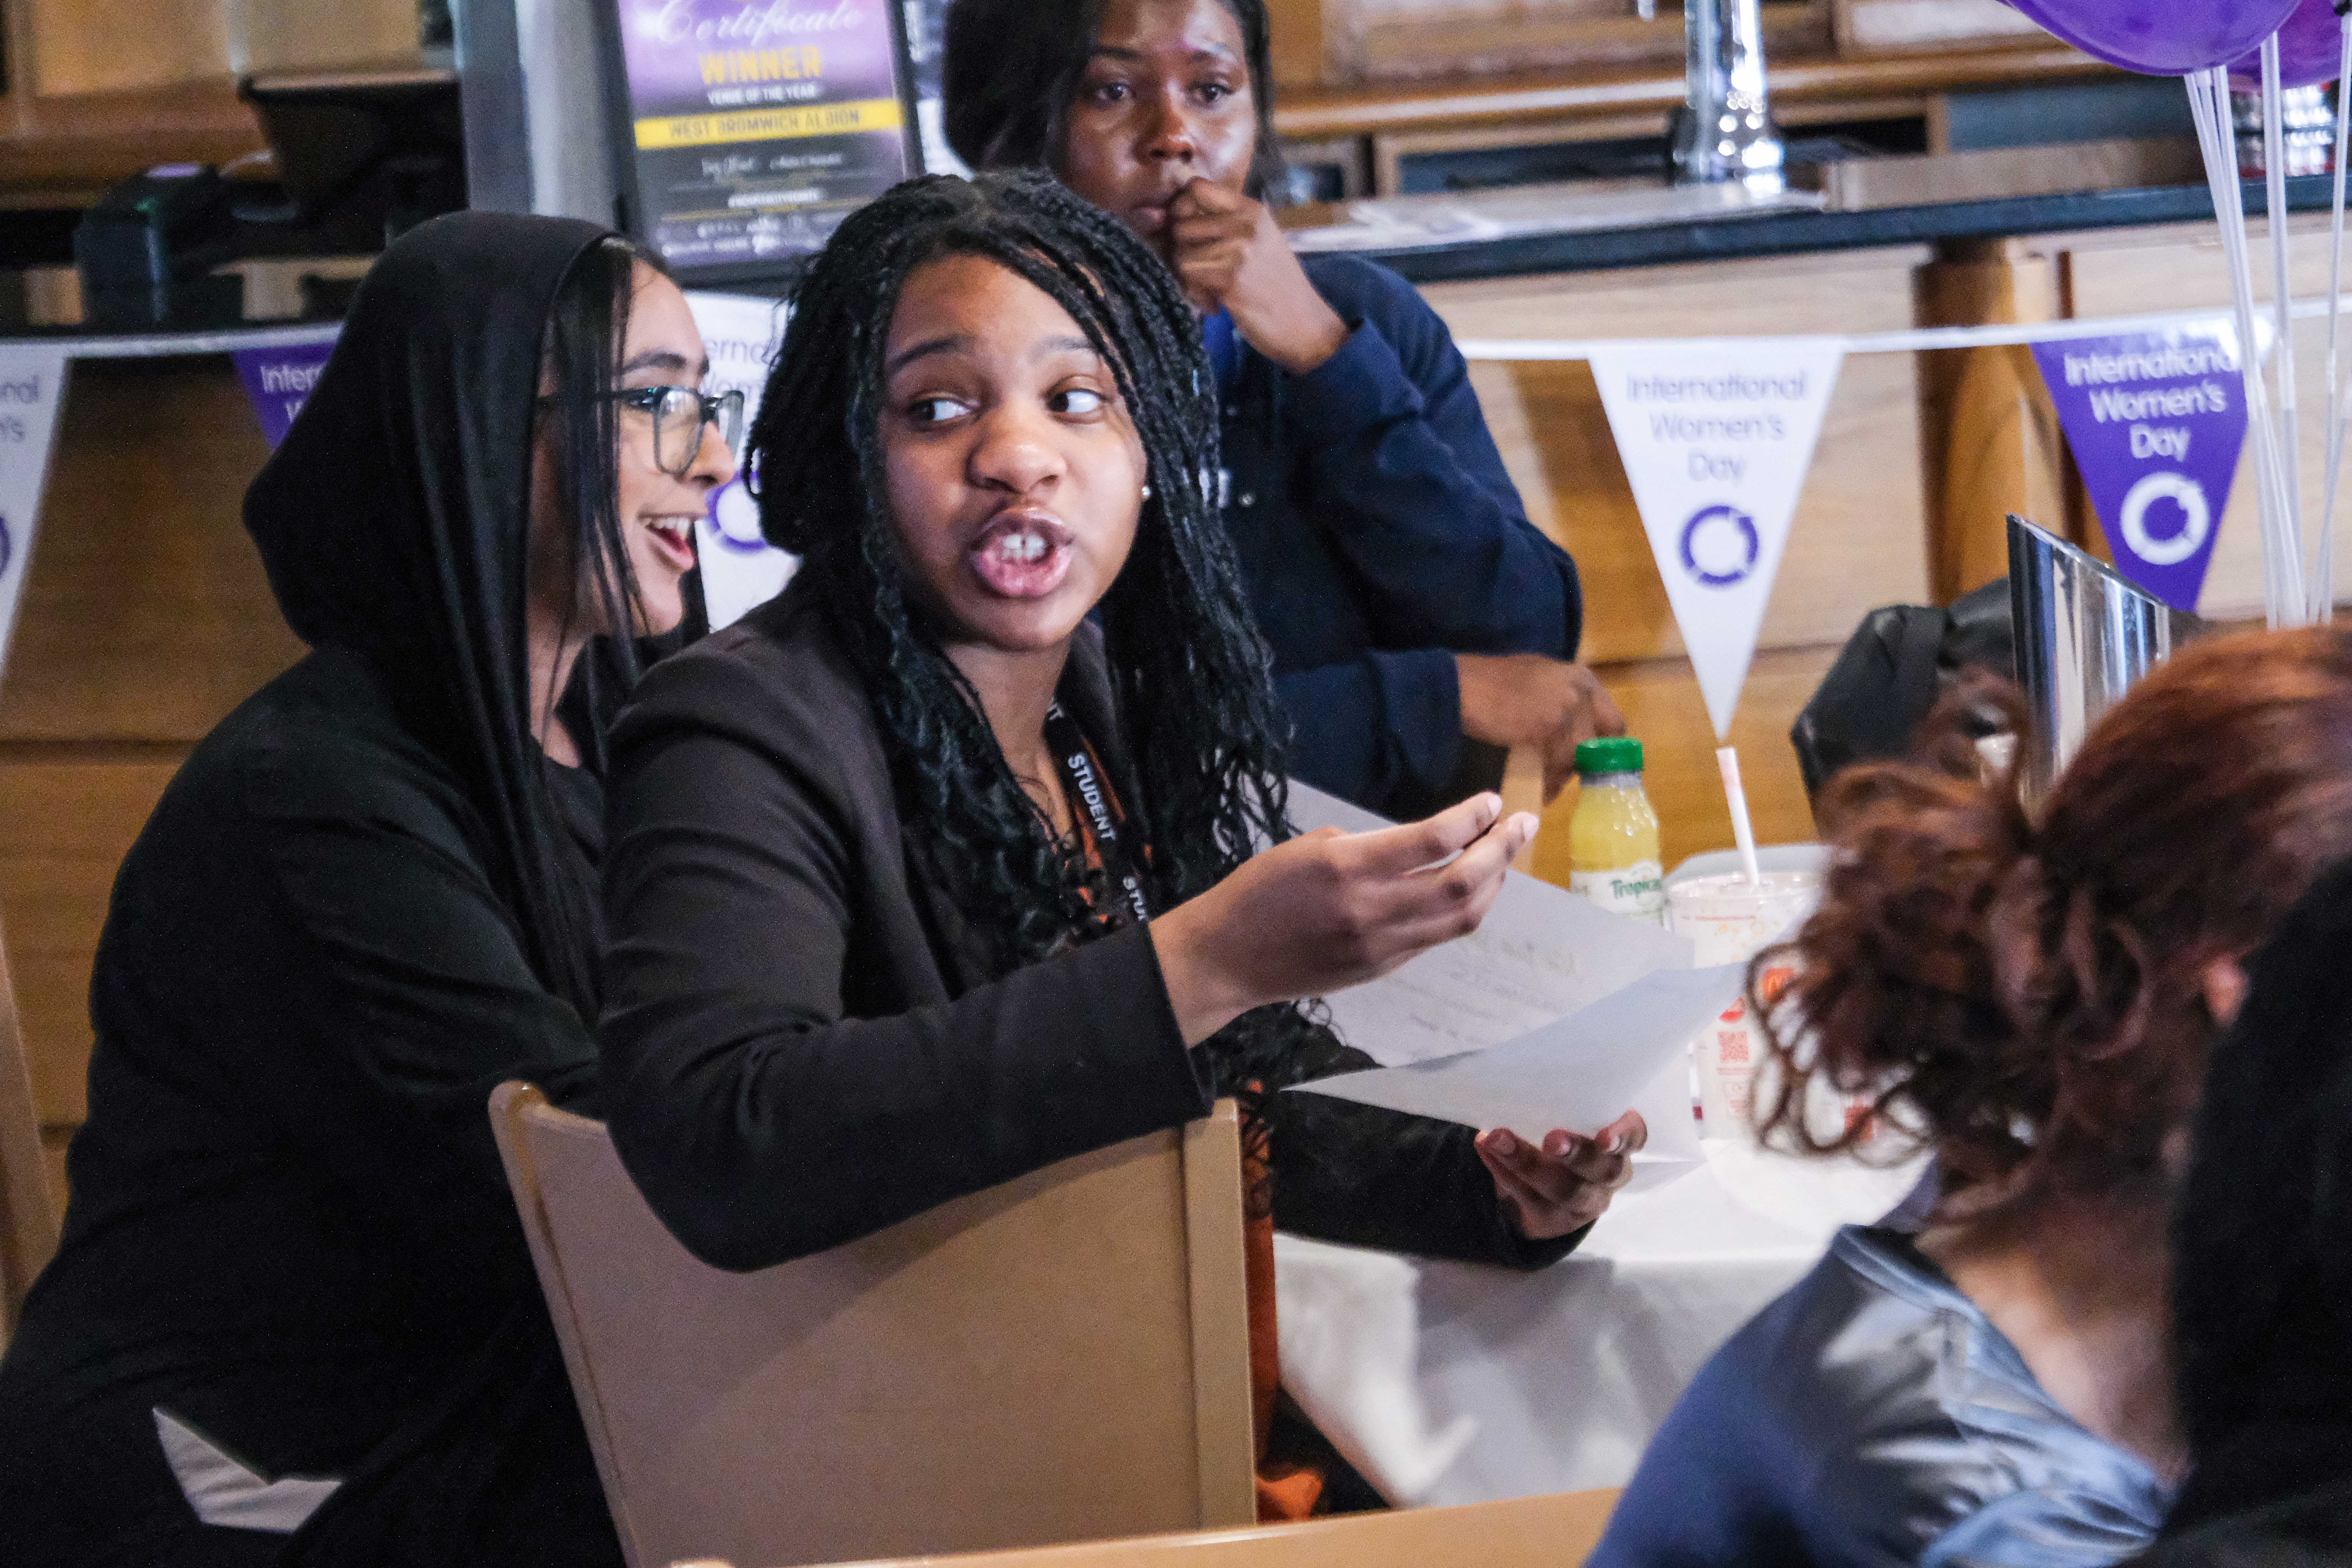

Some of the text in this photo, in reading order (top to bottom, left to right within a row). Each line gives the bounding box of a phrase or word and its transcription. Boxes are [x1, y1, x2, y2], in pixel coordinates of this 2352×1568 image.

[698, 45, 822, 85] WINNER
[785, 83, 817, 99] YEAR
[669, 108, 860, 140] WEST BROMWICH ALBION
[1626, 369, 1808, 403] International
[2088, 379, 2228, 424] Women's
[1650, 412, 1787, 442] Women's
[2130, 424, 2190, 462] Day
[1688, 448, 1746, 485] Day
[1068, 752, 1116, 841] STUDENT
